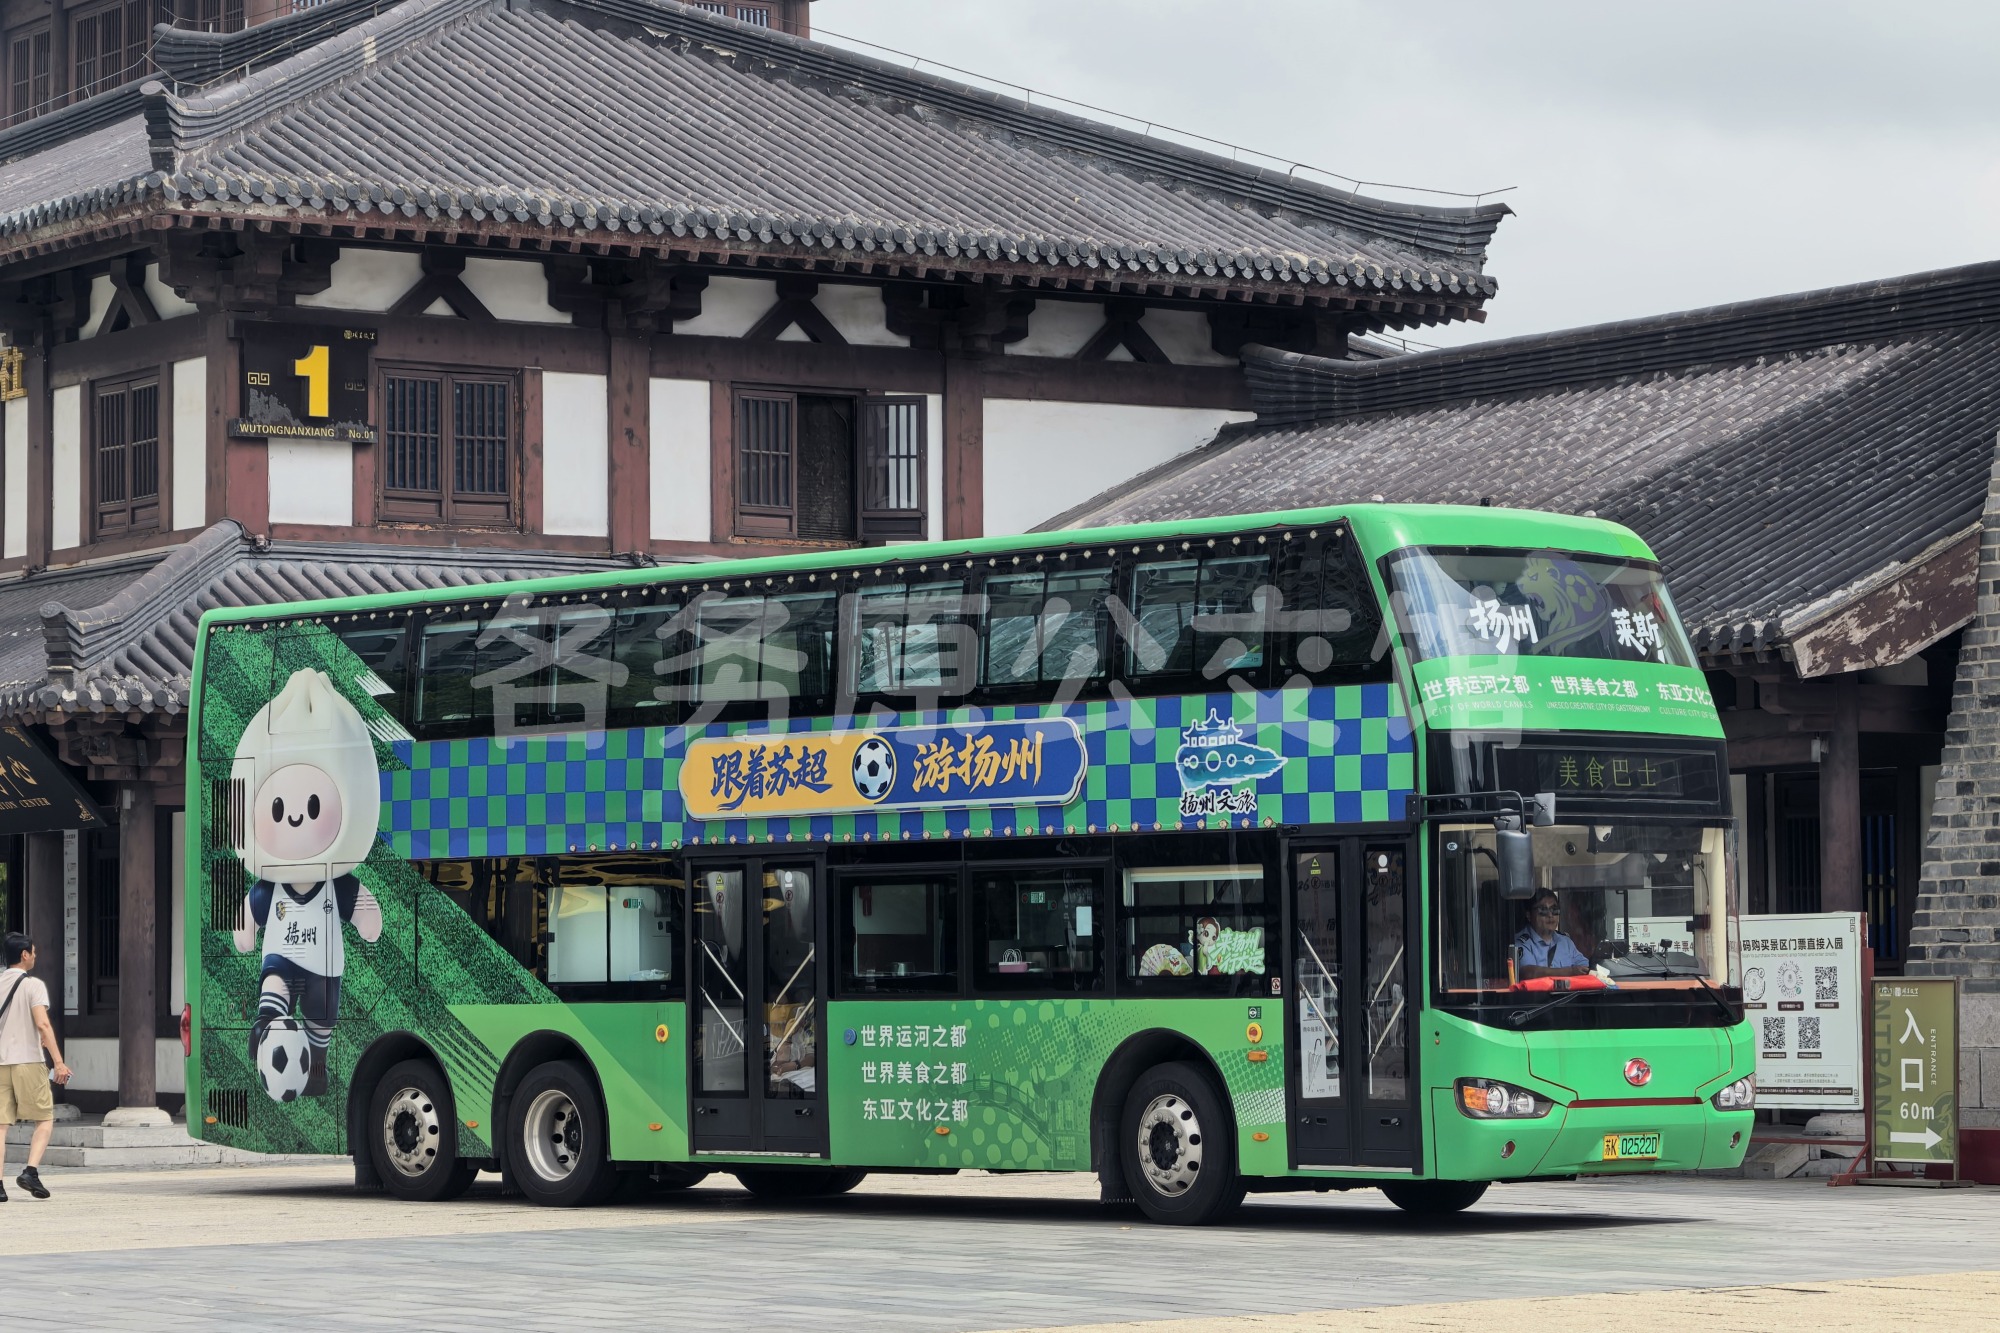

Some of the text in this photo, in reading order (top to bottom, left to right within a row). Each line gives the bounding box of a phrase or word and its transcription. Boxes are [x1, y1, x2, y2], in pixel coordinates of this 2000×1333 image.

[294, 345, 330, 418] 1
[239, 423, 375, 440] WUTONGNANXIANG No.01
[1469, 599, 1539, 654] 扬州
[1422, 674, 1530, 702] 世界运河之都
[1550, 675, 1639, 698] 世界美食之都
[1431, 699, 1535, 718] CITY OF WORLD CANALS
[1546, 701, 1570, 710] UNESCO
[1658, 706, 1687, 716] CULTURE
[710, 732, 1043, 813] 跟着苏超 游扬州
[1558, 755, 1657, 789] 美食巴士
[18, 797, 52, 808] CENTER
[1179, 788, 1257, 817] 扬州文旅
[284, 920, 318, 946] 揚州
[1740, 937, 1844, 952] 码购买景区门票直接入园
[861, 1025, 967, 1048] 世界运河之都
[1899, 1007, 1925, 1092] 入口
[861, 1061, 968, 1085] 世界美食之都
[1874, 985, 1892, 1158] NTRANCE
[862, 1098, 969, 1122] 东亚文化之都
[1899, 1101, 1935, 1120] 60m
[1621, 1136, 1657, 1155] 02522D
